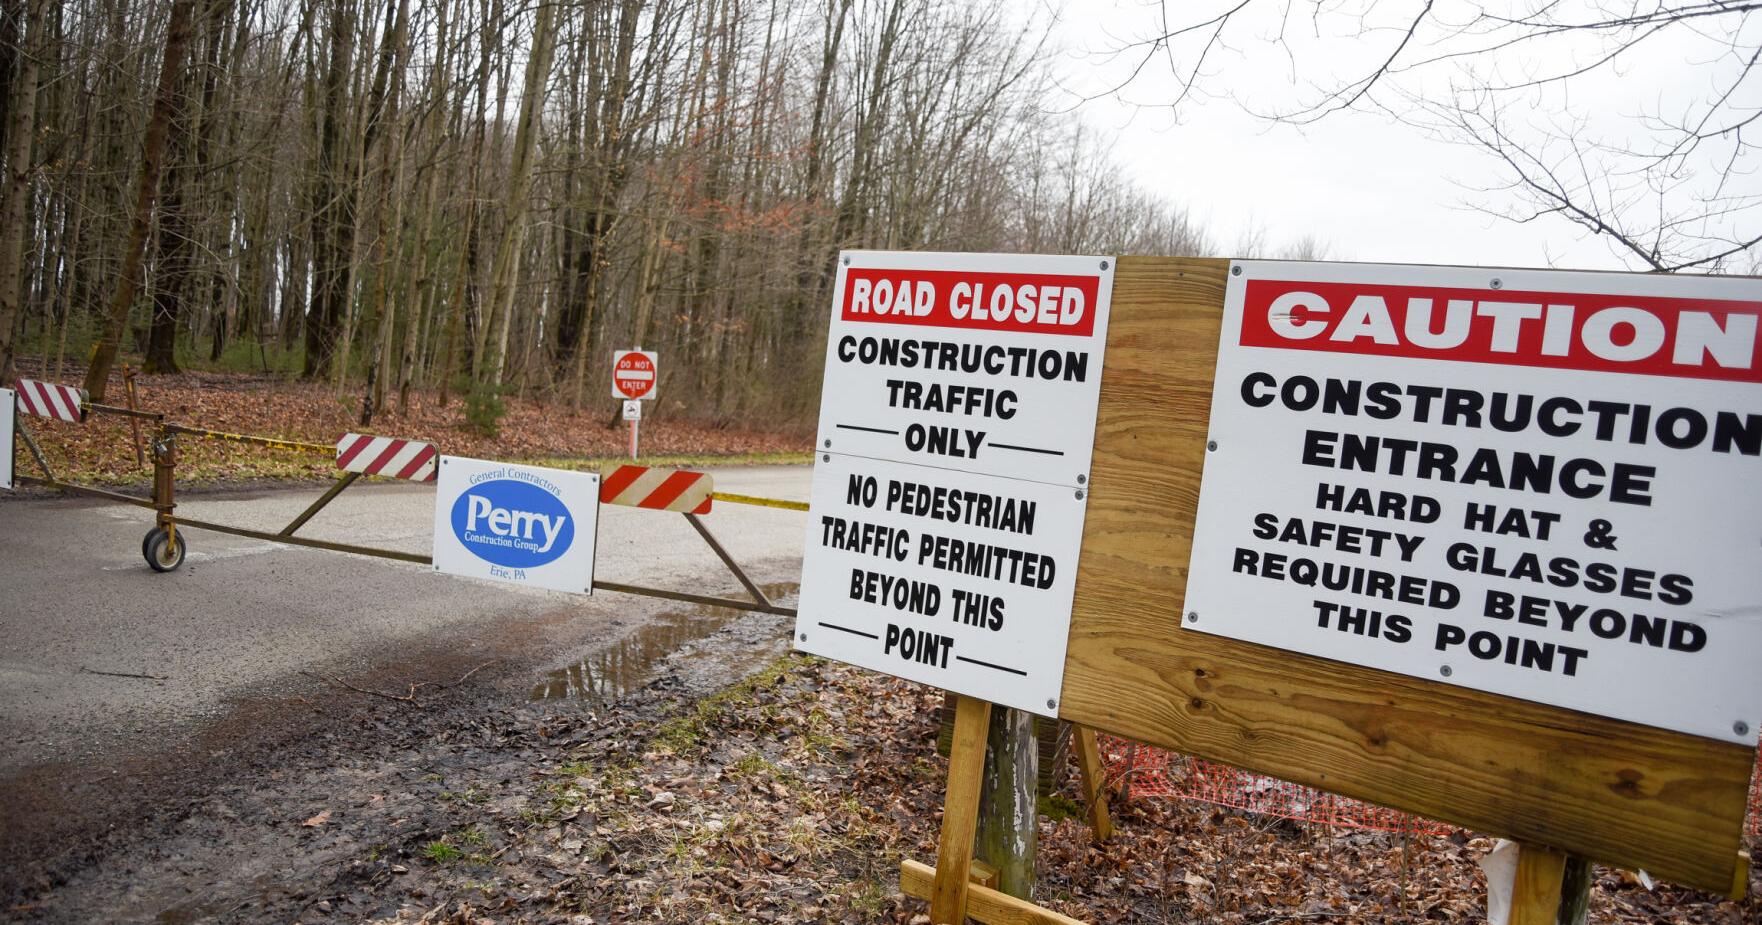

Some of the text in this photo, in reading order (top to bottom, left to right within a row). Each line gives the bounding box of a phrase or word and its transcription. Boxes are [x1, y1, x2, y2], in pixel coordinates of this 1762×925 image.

[850, 277, 1085, 327] ROAD CLOSED
[1267, 290, 1760, 370] CAUTION
[620, 360, 650, 369] DO NOT
[838, 334, 1088, 382] CONSTRUCTION
[886, 379, 1018, 420] TRAFFIC
[1240, 371, 1762, 456] CONSTRUCTION
[905, 423, 987, 460] ONLY
[1302, 430, 1657, 506] ENTRANCE
[469, 467, 562, 497] General Contractors
[846, 473, 1037, 535] NO PEDESTRIAN
[464, 531, 538, 553] Construction Group
[466, 494, 566, 553] Perry
[1315, 482, 1618, 551] HARD HAT &
[490, 565, 526, 579] Erie, PA
[821, 515, 1056, 591] TRAFFIC PERMITTED
[1252, 512, 1694, 606] SAFETY GLASSES
[849, 568, 1005, 632] BEYOND THIS
[1232, 547, 1708, 654] REQUIRED BEYOND
[884, 624, 955, 669] POINT
[1313, 600, 1589, 678] THIS POINT
